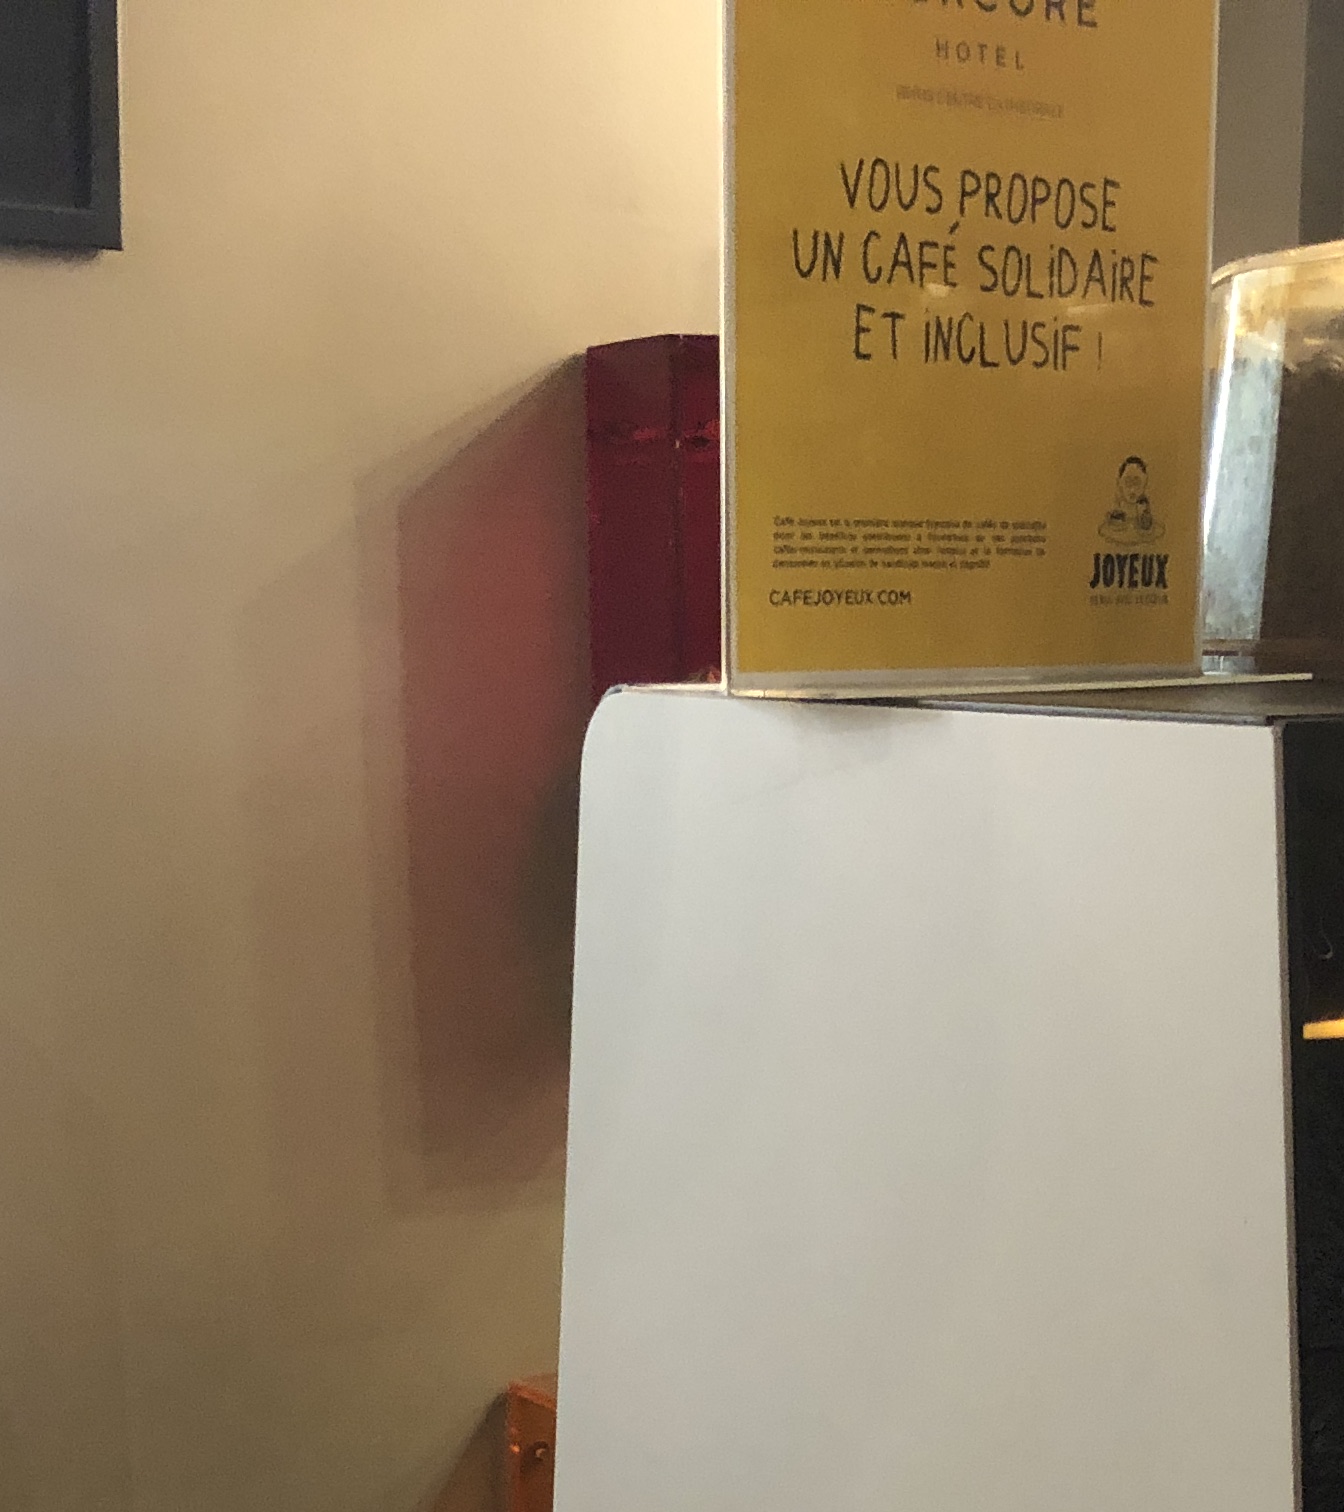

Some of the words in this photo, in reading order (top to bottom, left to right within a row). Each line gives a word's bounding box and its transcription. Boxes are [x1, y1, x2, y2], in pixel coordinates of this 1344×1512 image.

[935, 37, 1025, 71] HOTEL
[840, 157, 944, 215] VOUS
[959, 169, 1121, 232] PROPOSE
[792, 228, 845, 282] UN
[862, 221, 958, 289] CAFÉ
[853, 303, 906, 361] ET
[1089, 552, 1170, 590] JOYEUX
